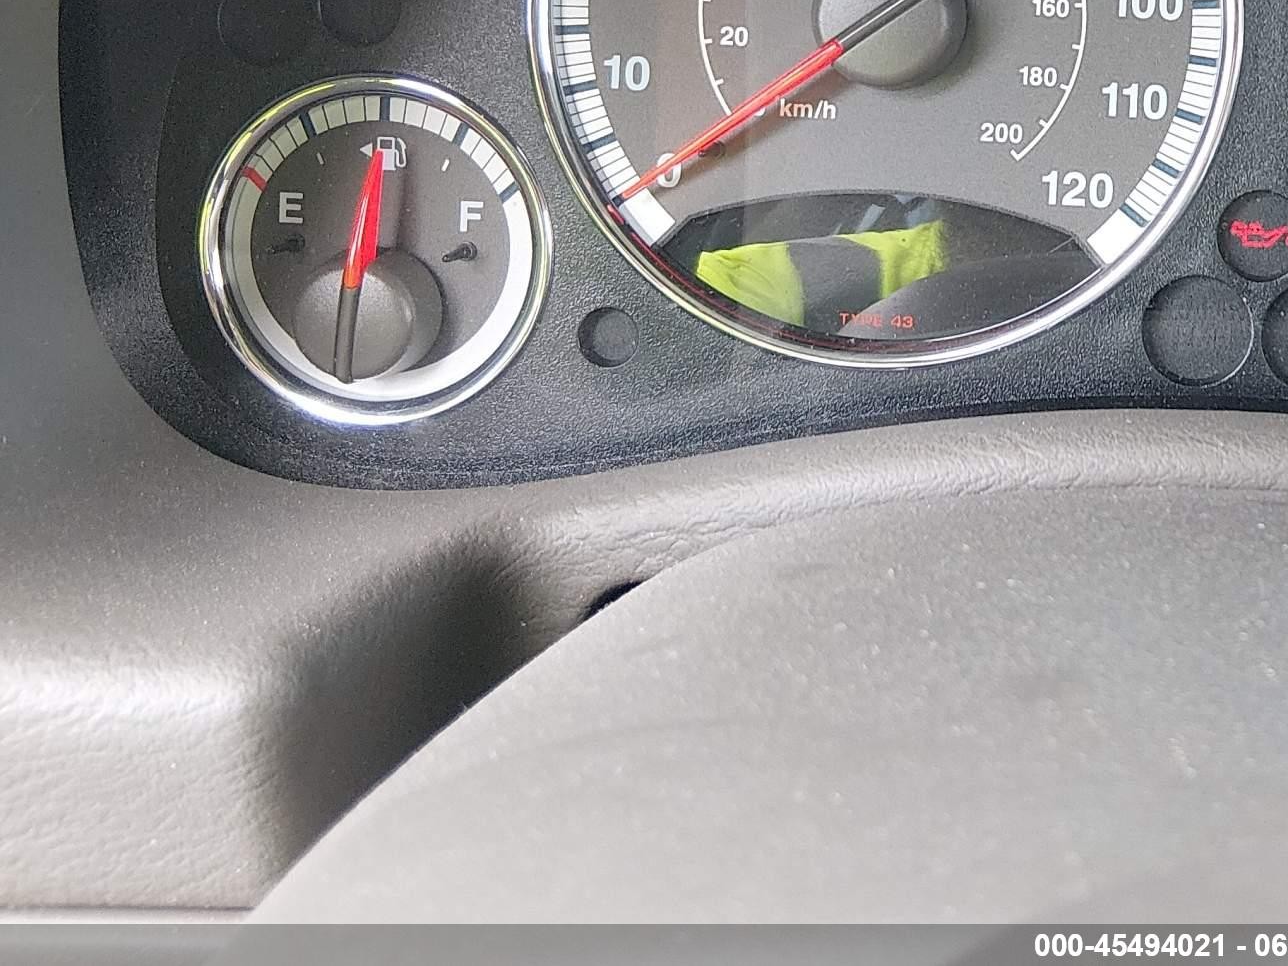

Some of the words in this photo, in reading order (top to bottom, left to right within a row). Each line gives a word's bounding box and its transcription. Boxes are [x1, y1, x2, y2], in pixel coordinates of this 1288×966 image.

[720, 26, 748, 46] 20
[604, 55, 649, 90] 10
[1019, 66, 1057, 87] 180
[779, 98, 837, 120] km/h
[1102, 83, 1167, 119] 110
[980, 123, 1022, 144] 200
[1042, 171, 1113, 208] 120
[279, 192, 303, 223] E
[460, 201, 483, 232] F
